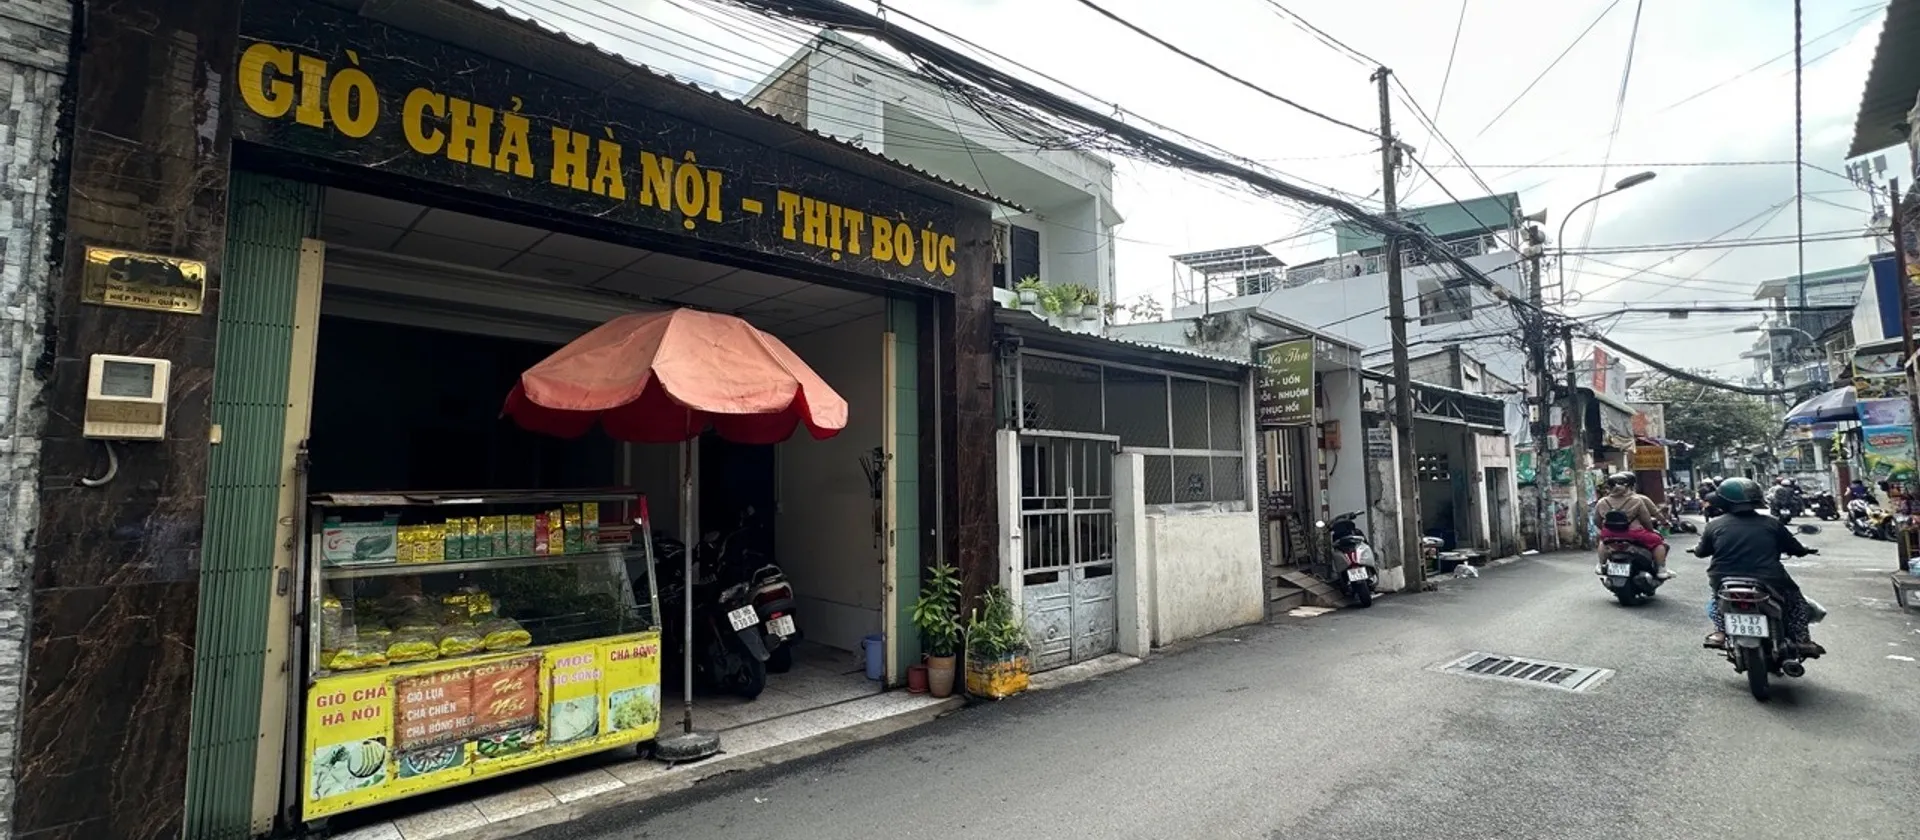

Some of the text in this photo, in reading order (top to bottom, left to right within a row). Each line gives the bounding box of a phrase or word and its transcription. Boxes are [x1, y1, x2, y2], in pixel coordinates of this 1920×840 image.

[238, 43, 380, 138] GIÒ
[402, 87, 534, 178] CHẢ
[550, 126, 626, 200] HÀ
[640, 150, 723, 230] NỘI
[778, 190, 864, 260] THỊT
[872, 211, 915, 267] BÒ
[921, 222, 957, 277] ÚC
[316, 681, 388, 708] GIÒ CHẢ
[321, 704, 381, 727] HÀ NỘI
